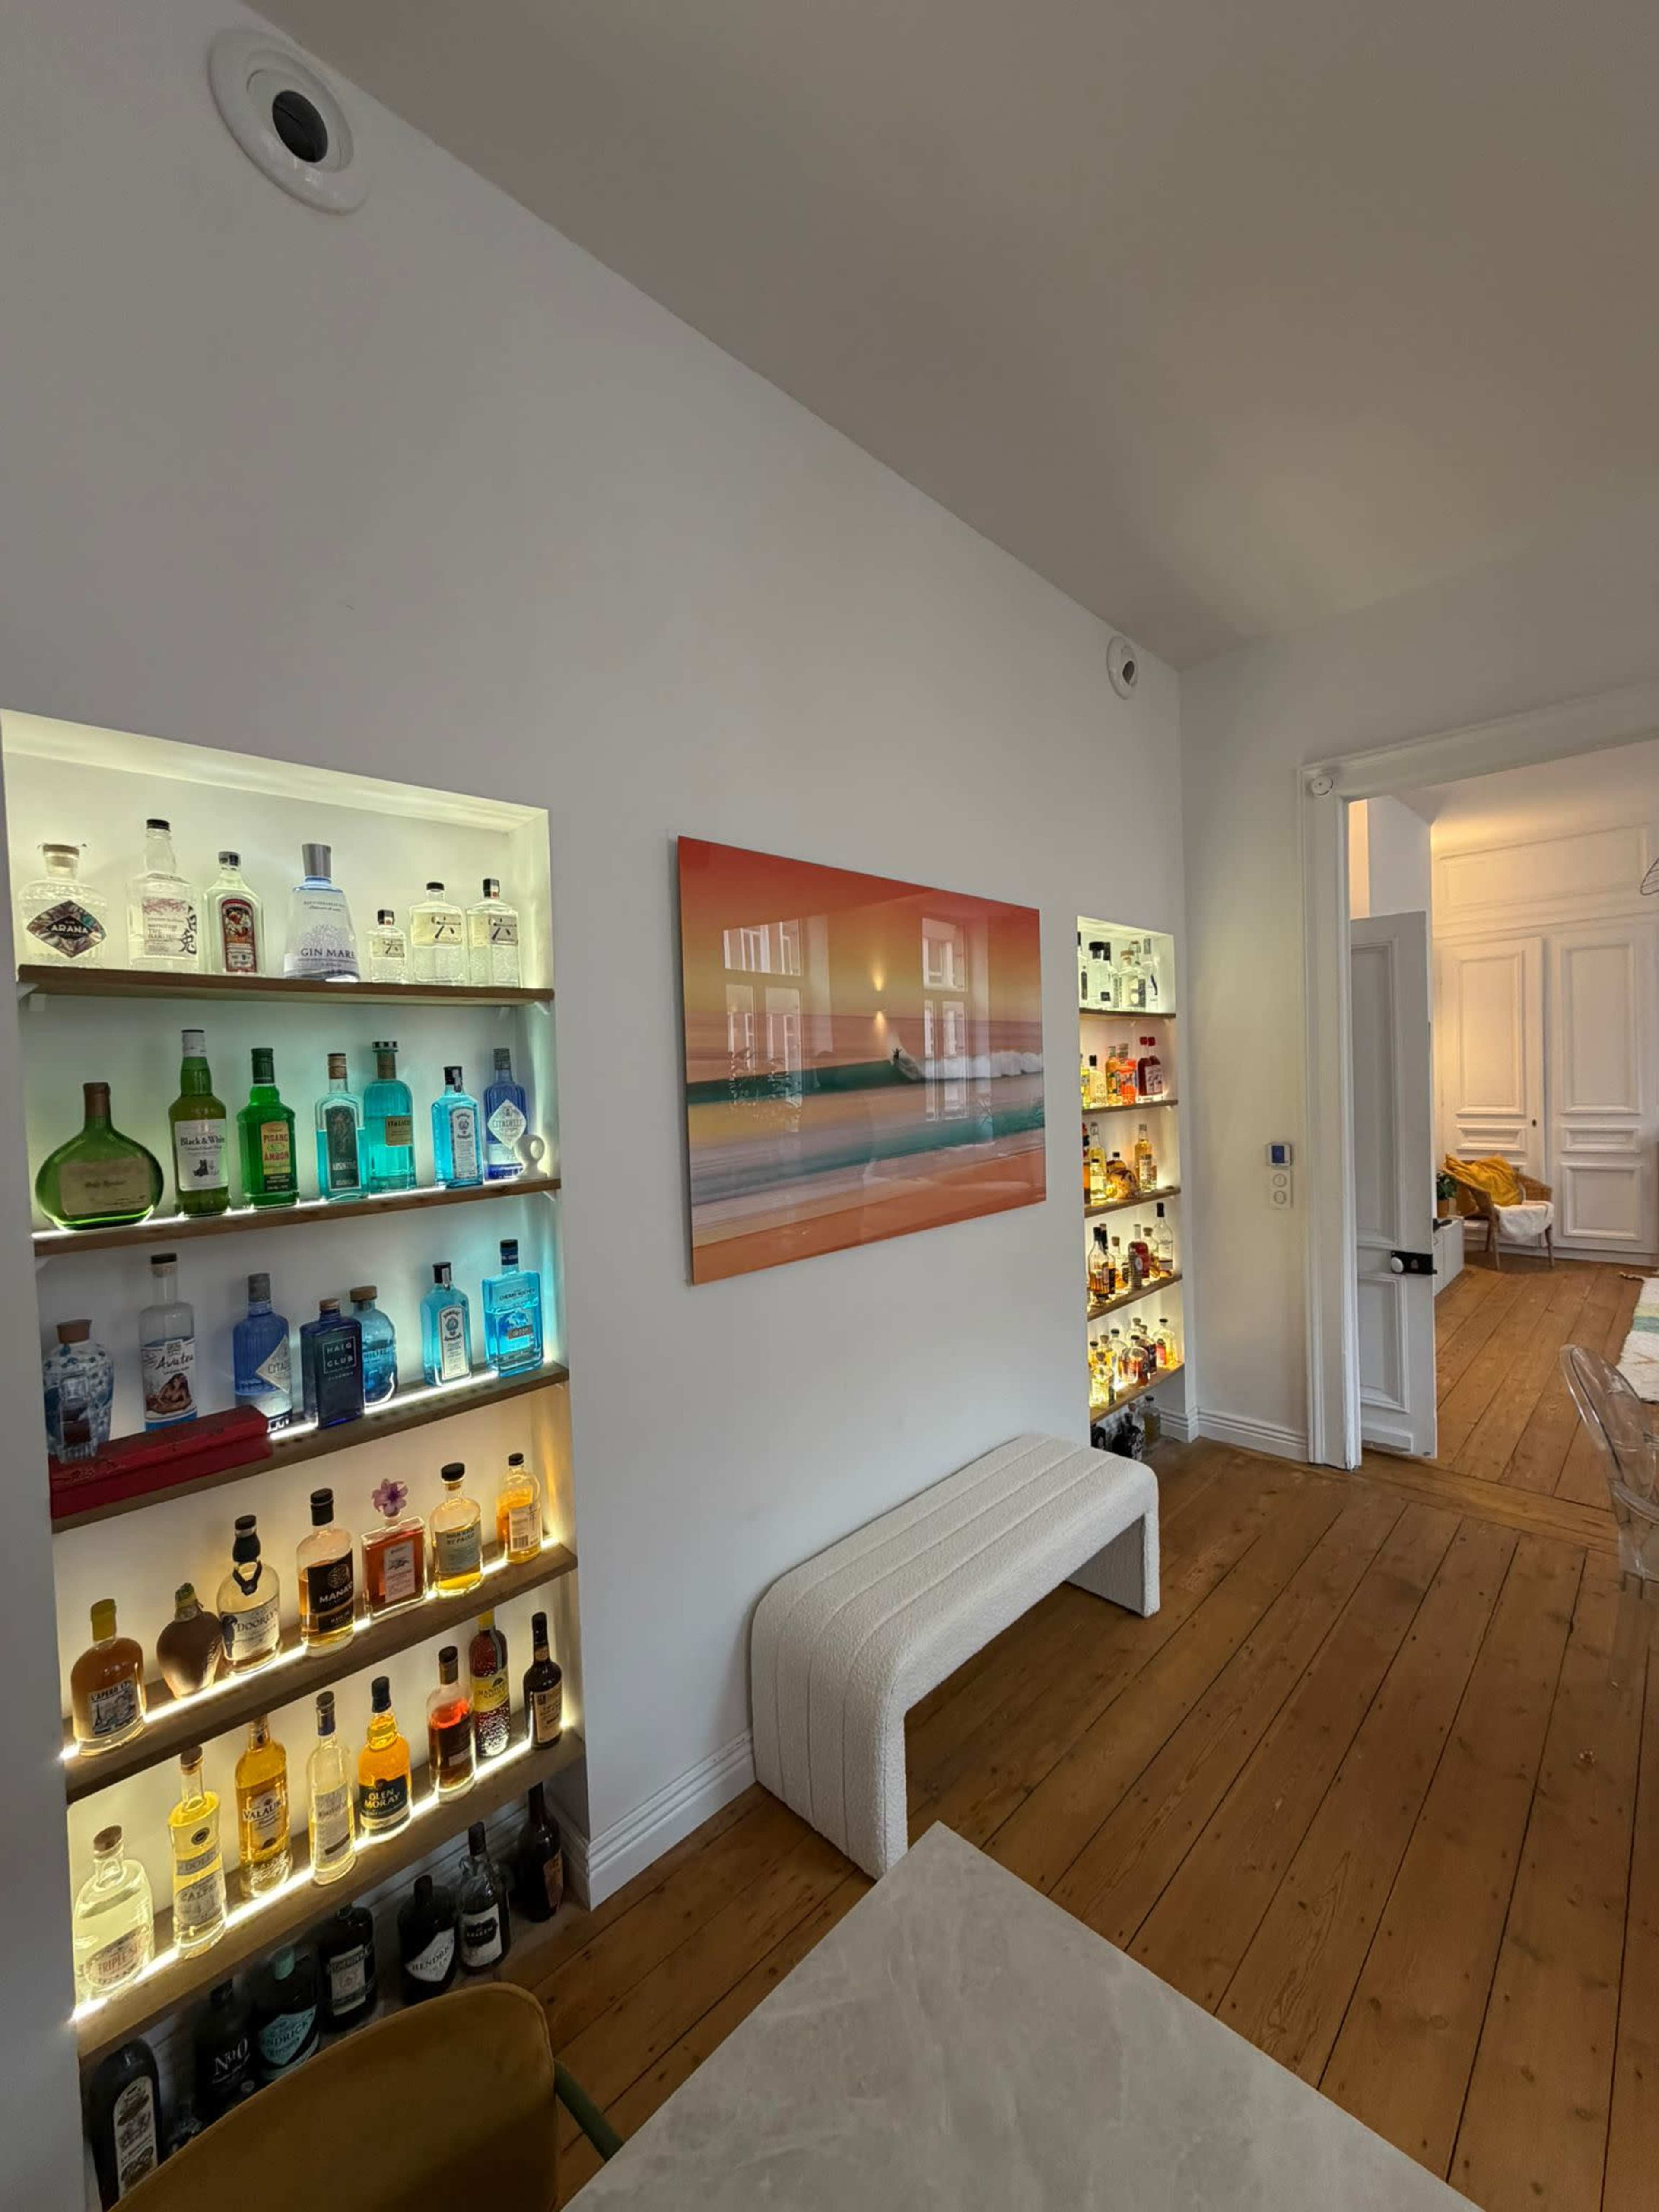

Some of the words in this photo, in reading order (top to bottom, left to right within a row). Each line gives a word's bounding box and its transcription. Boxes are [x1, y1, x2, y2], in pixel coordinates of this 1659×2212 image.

[301, 947, 323, 957] GIN
[180, 1136, 200, 1146] Black
[327, 1355, 353, 1367] CLUB
